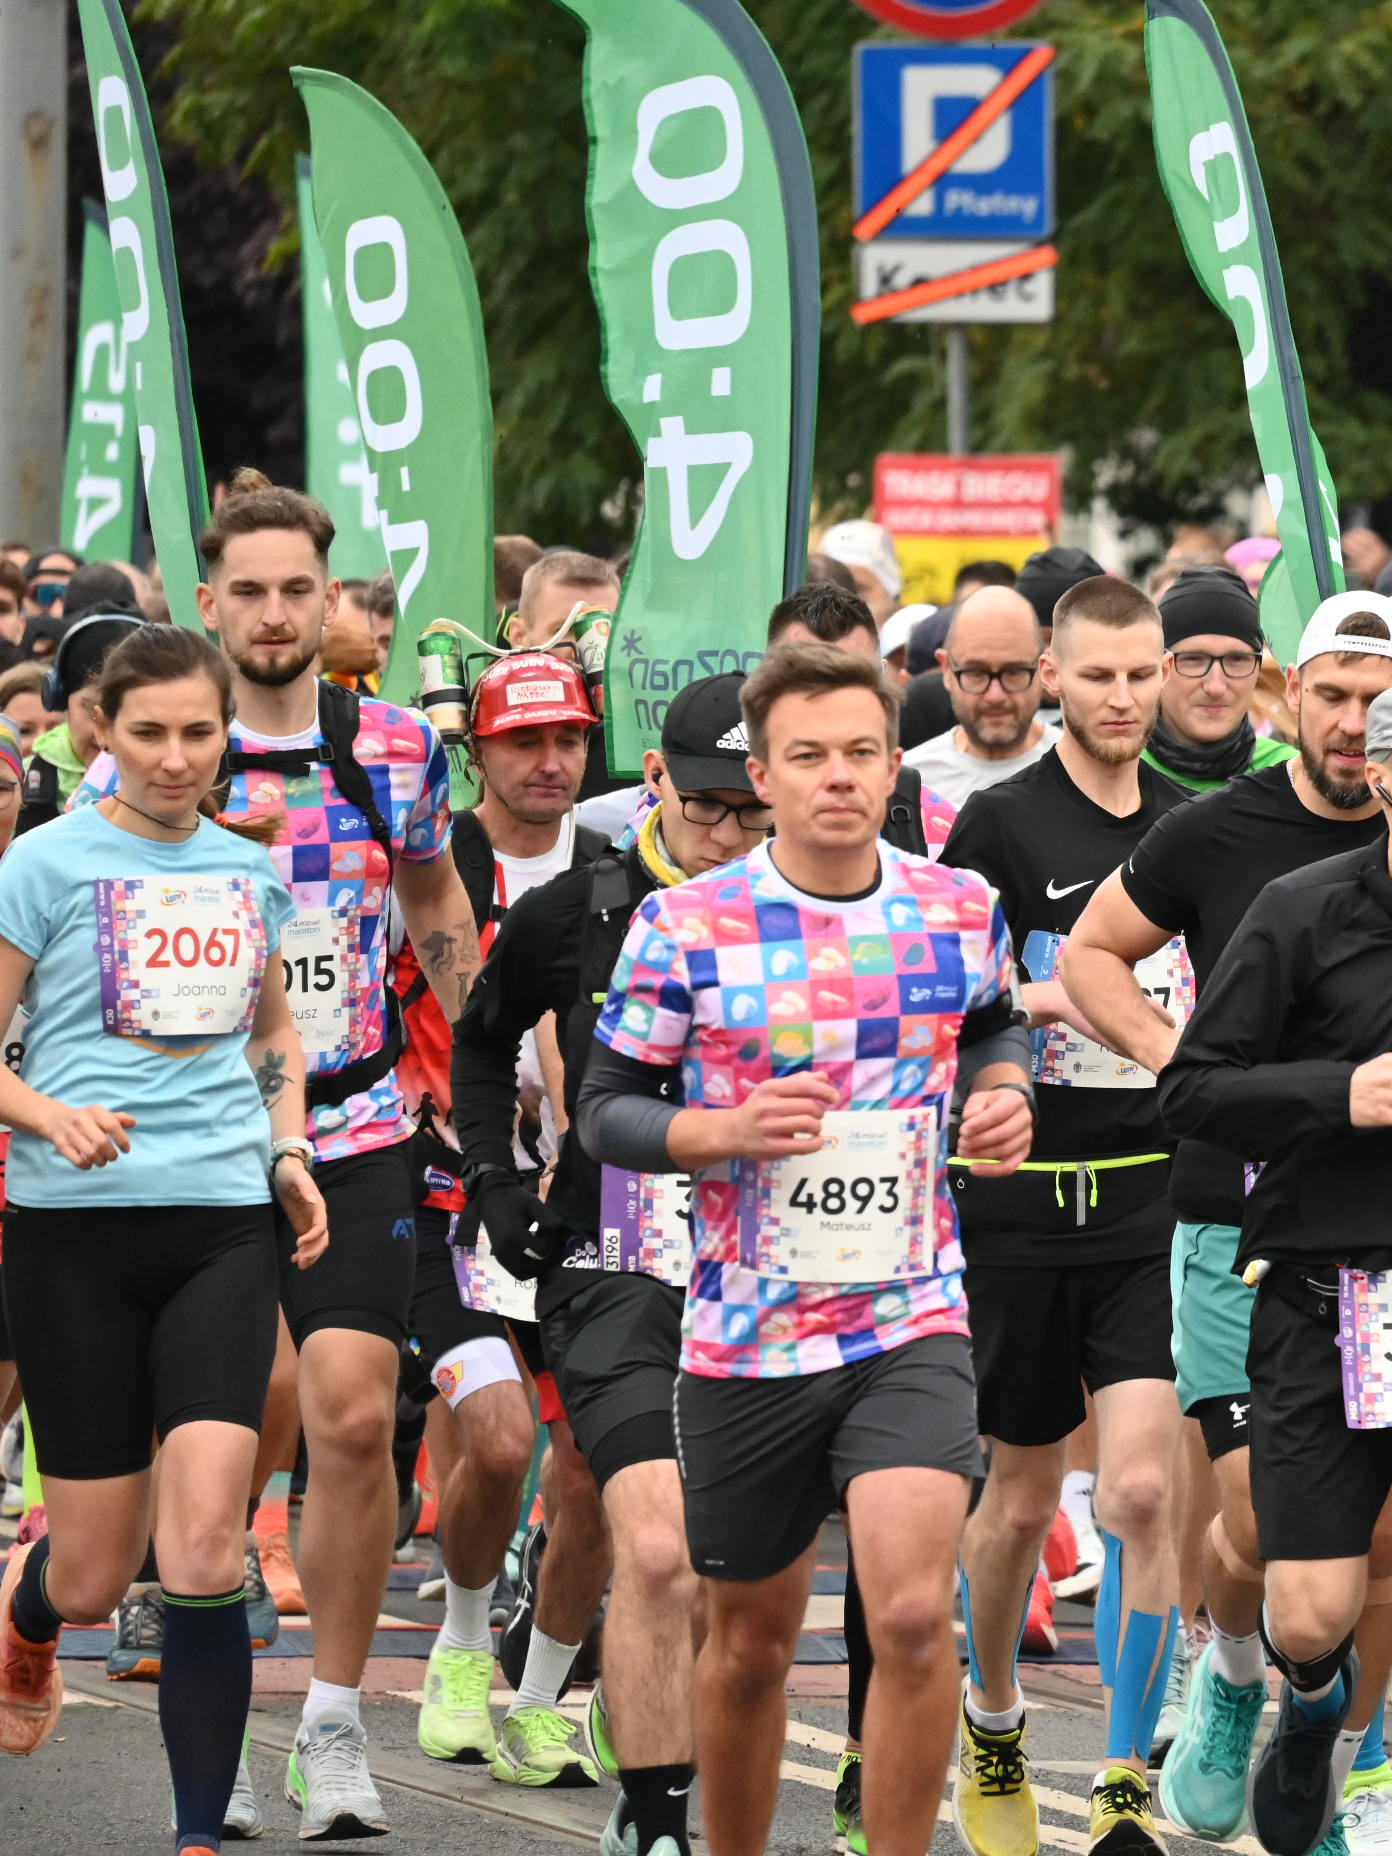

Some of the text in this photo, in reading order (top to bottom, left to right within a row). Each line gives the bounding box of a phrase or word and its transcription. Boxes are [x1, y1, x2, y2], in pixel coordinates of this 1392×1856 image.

[287, 926, 321, 937] maraton
[143, 926, 241, 968] 2067
[172, 983, 227, 997] Joanna
[1031, 1054, 1039, 1073] M30
[788, 1176, 899, 1215] 4893
[819, 1220, 872, 1232] Mateusz
[575, 1248, 587, 1257] Do
[604, 1235, 619, 1269] 3196
